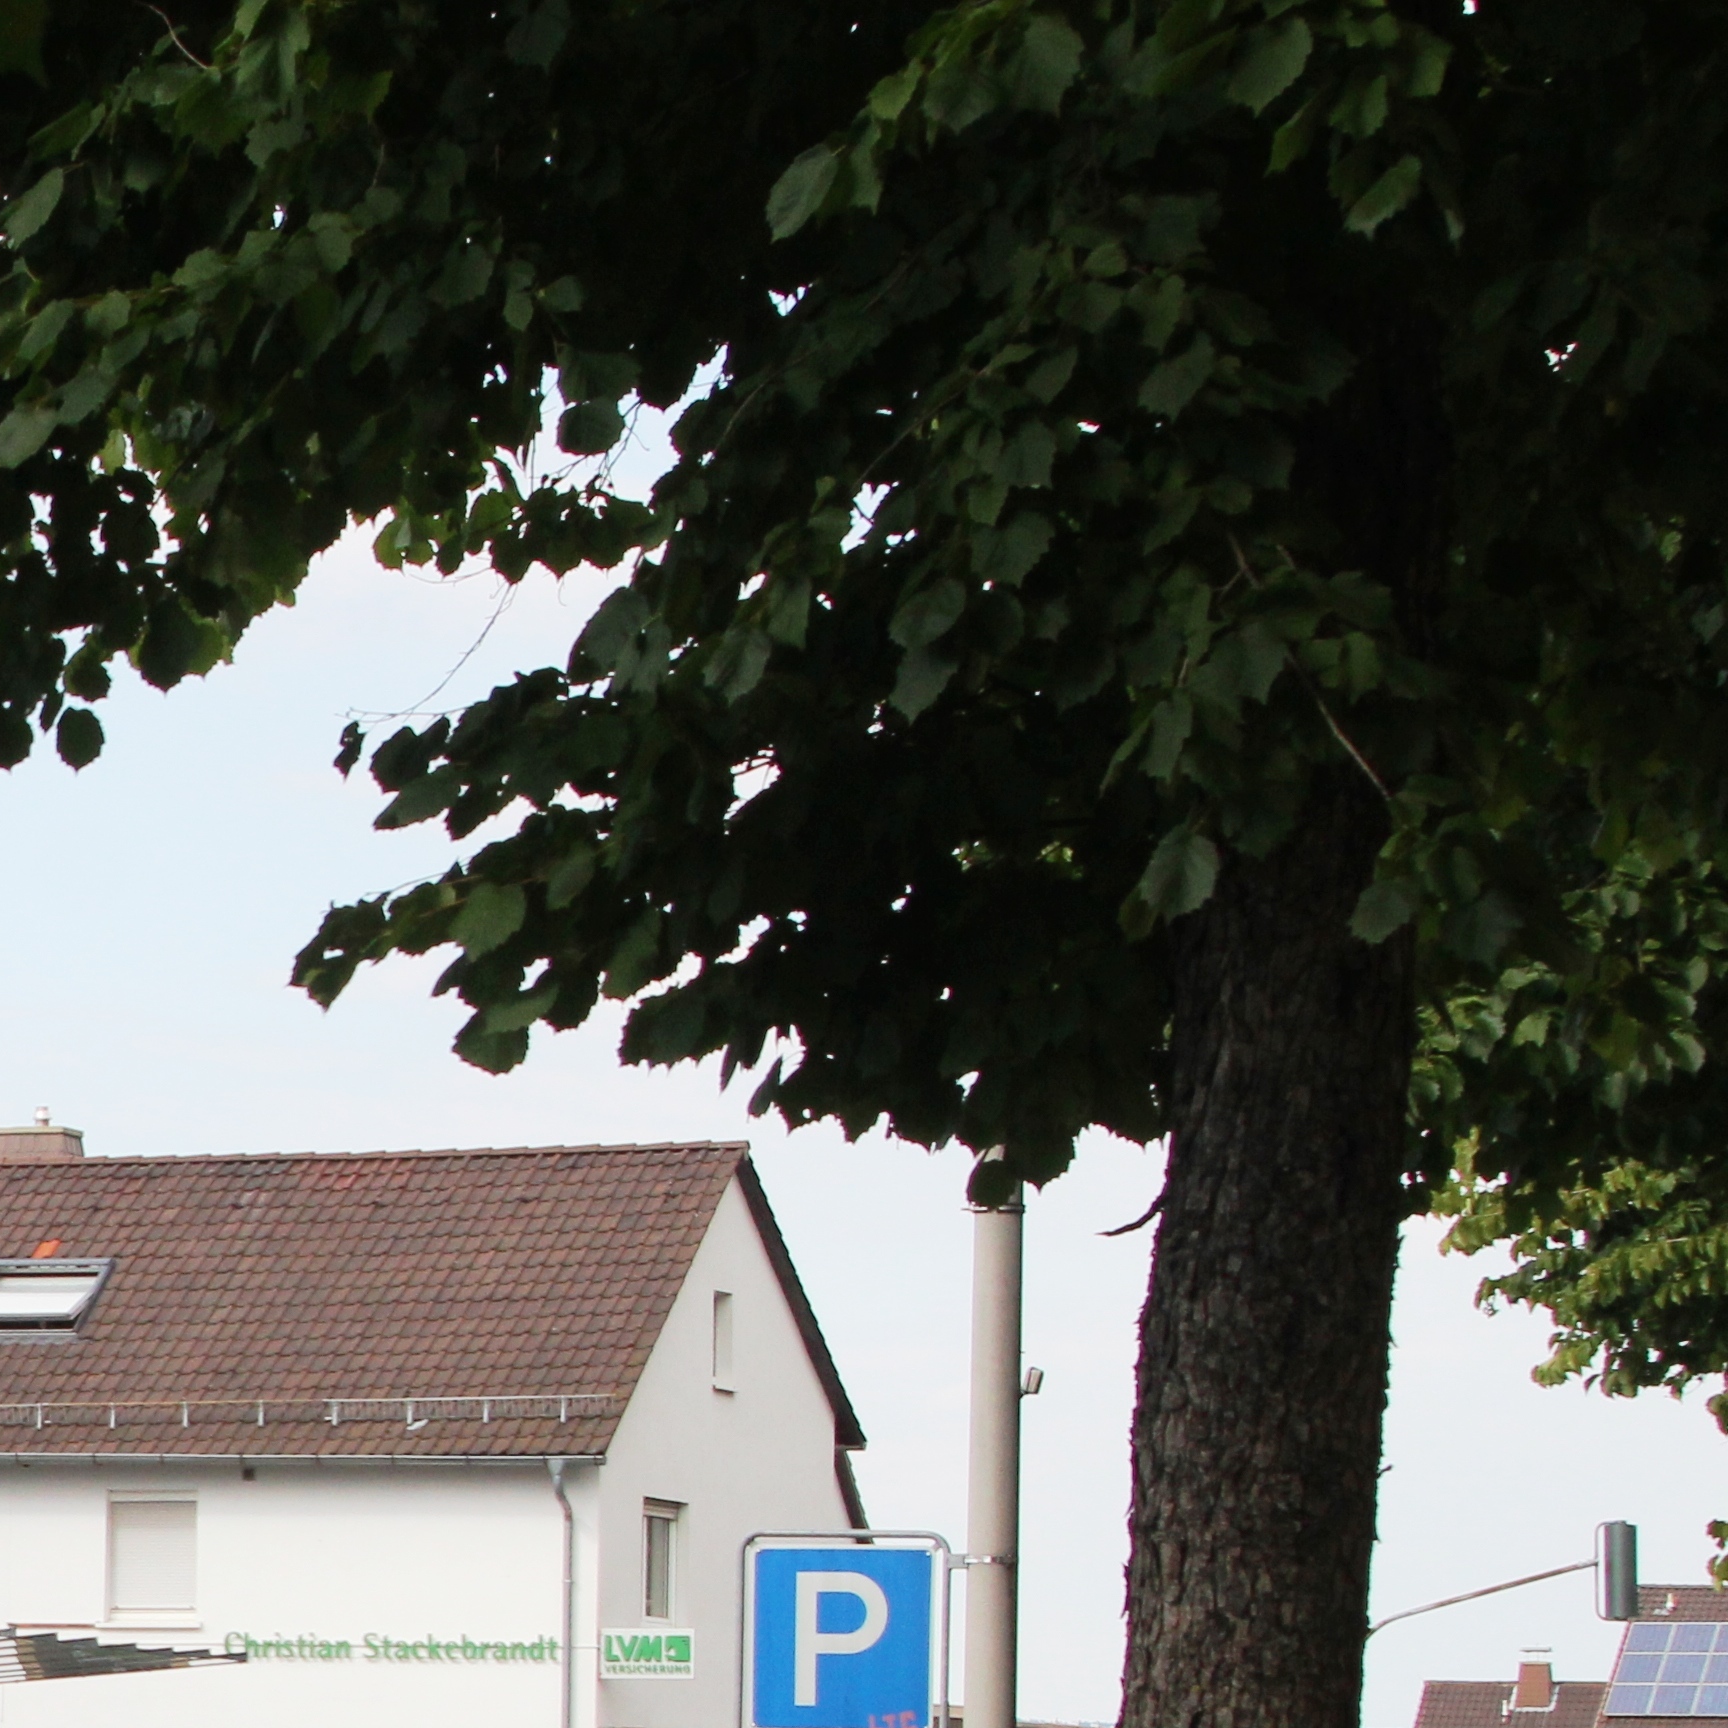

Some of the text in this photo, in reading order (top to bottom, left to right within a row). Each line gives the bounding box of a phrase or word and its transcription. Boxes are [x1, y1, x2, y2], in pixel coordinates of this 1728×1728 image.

[224, 1631, 560, 1663] Christian Stackebrandt
[604, 1635, 662, 1662] LVM
[794, 1571, 889, 1707] P
